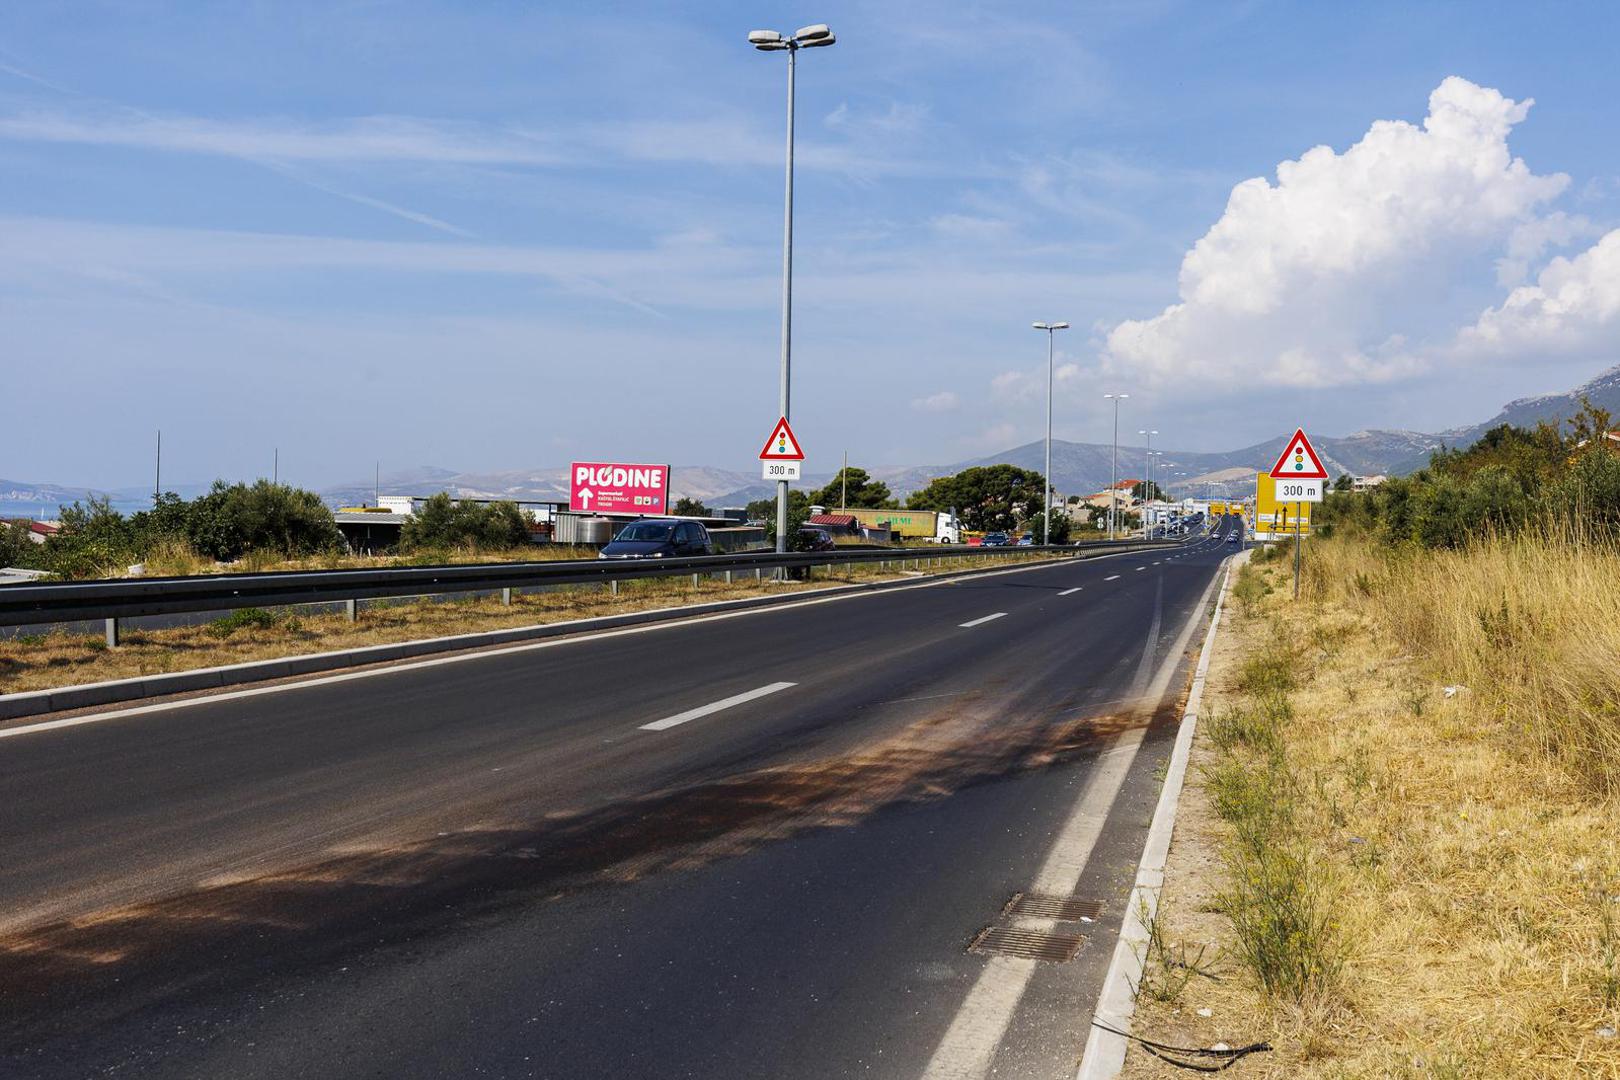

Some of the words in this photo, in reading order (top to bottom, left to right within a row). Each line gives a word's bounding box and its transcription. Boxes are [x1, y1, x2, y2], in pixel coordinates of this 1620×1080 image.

[769, 465, 785, 475] 300
[788, 467, 795, 475] m
[576, 466, 662, 489] PLODINE
[1283, 485, 1303, 496] 300
[1307, 487, 1316, 496] m
